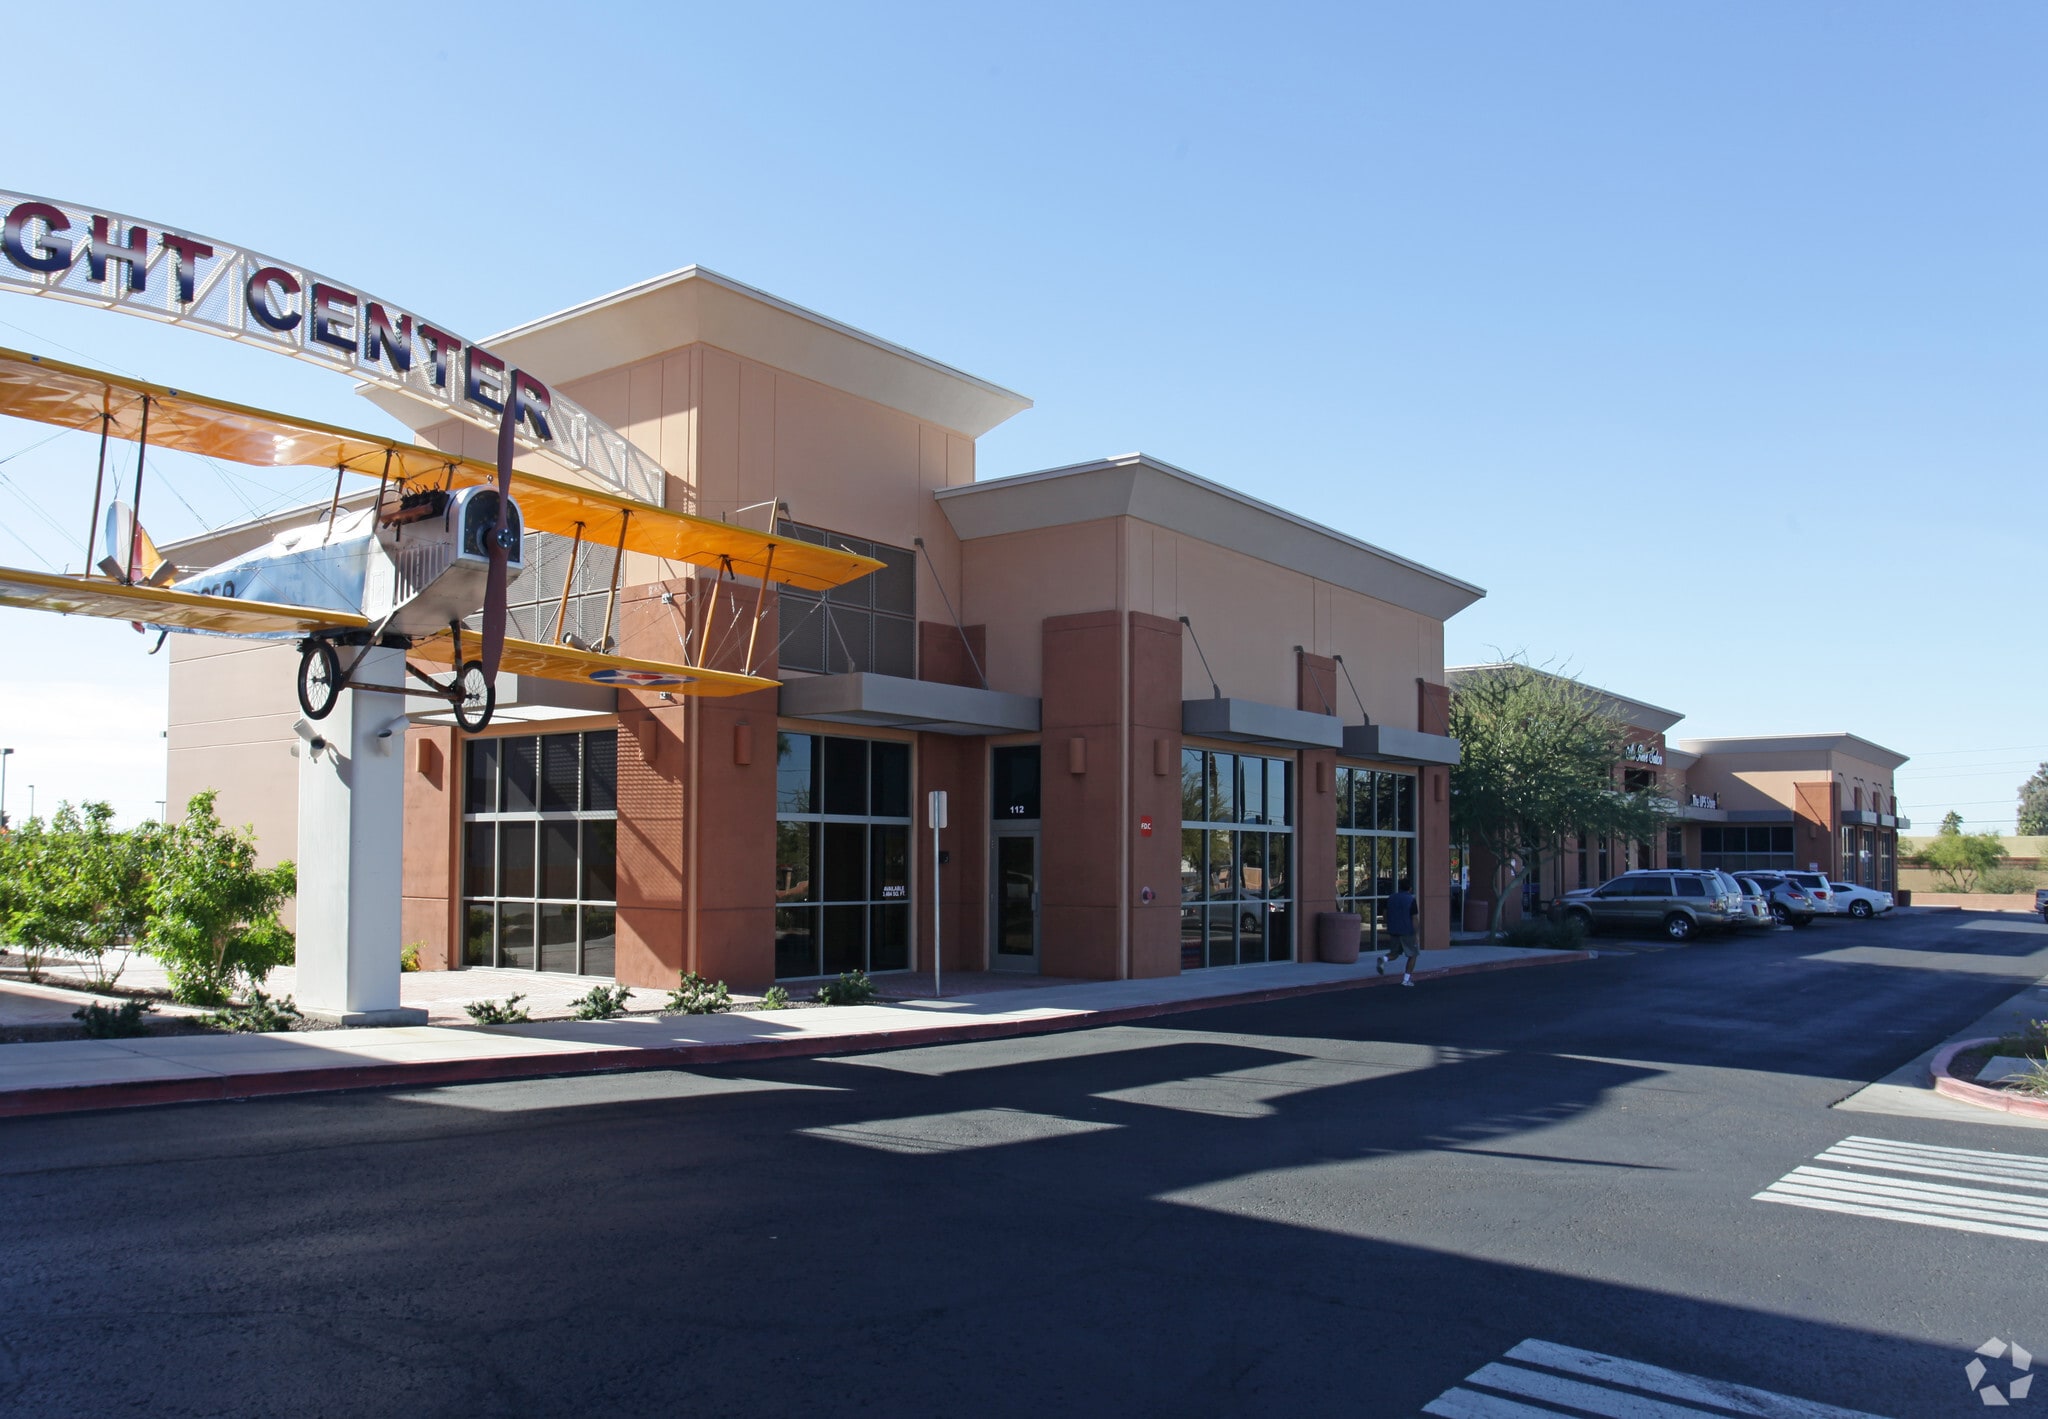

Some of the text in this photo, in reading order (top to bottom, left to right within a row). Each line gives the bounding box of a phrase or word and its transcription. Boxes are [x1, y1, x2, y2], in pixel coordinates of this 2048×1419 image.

[3, 202, 553, 442] GHT CENTER
[1699, 795, 1707, 809] UPS
[1010, 805, 1025, 814] 112
[1141, 822, 1152, 830] FDC
